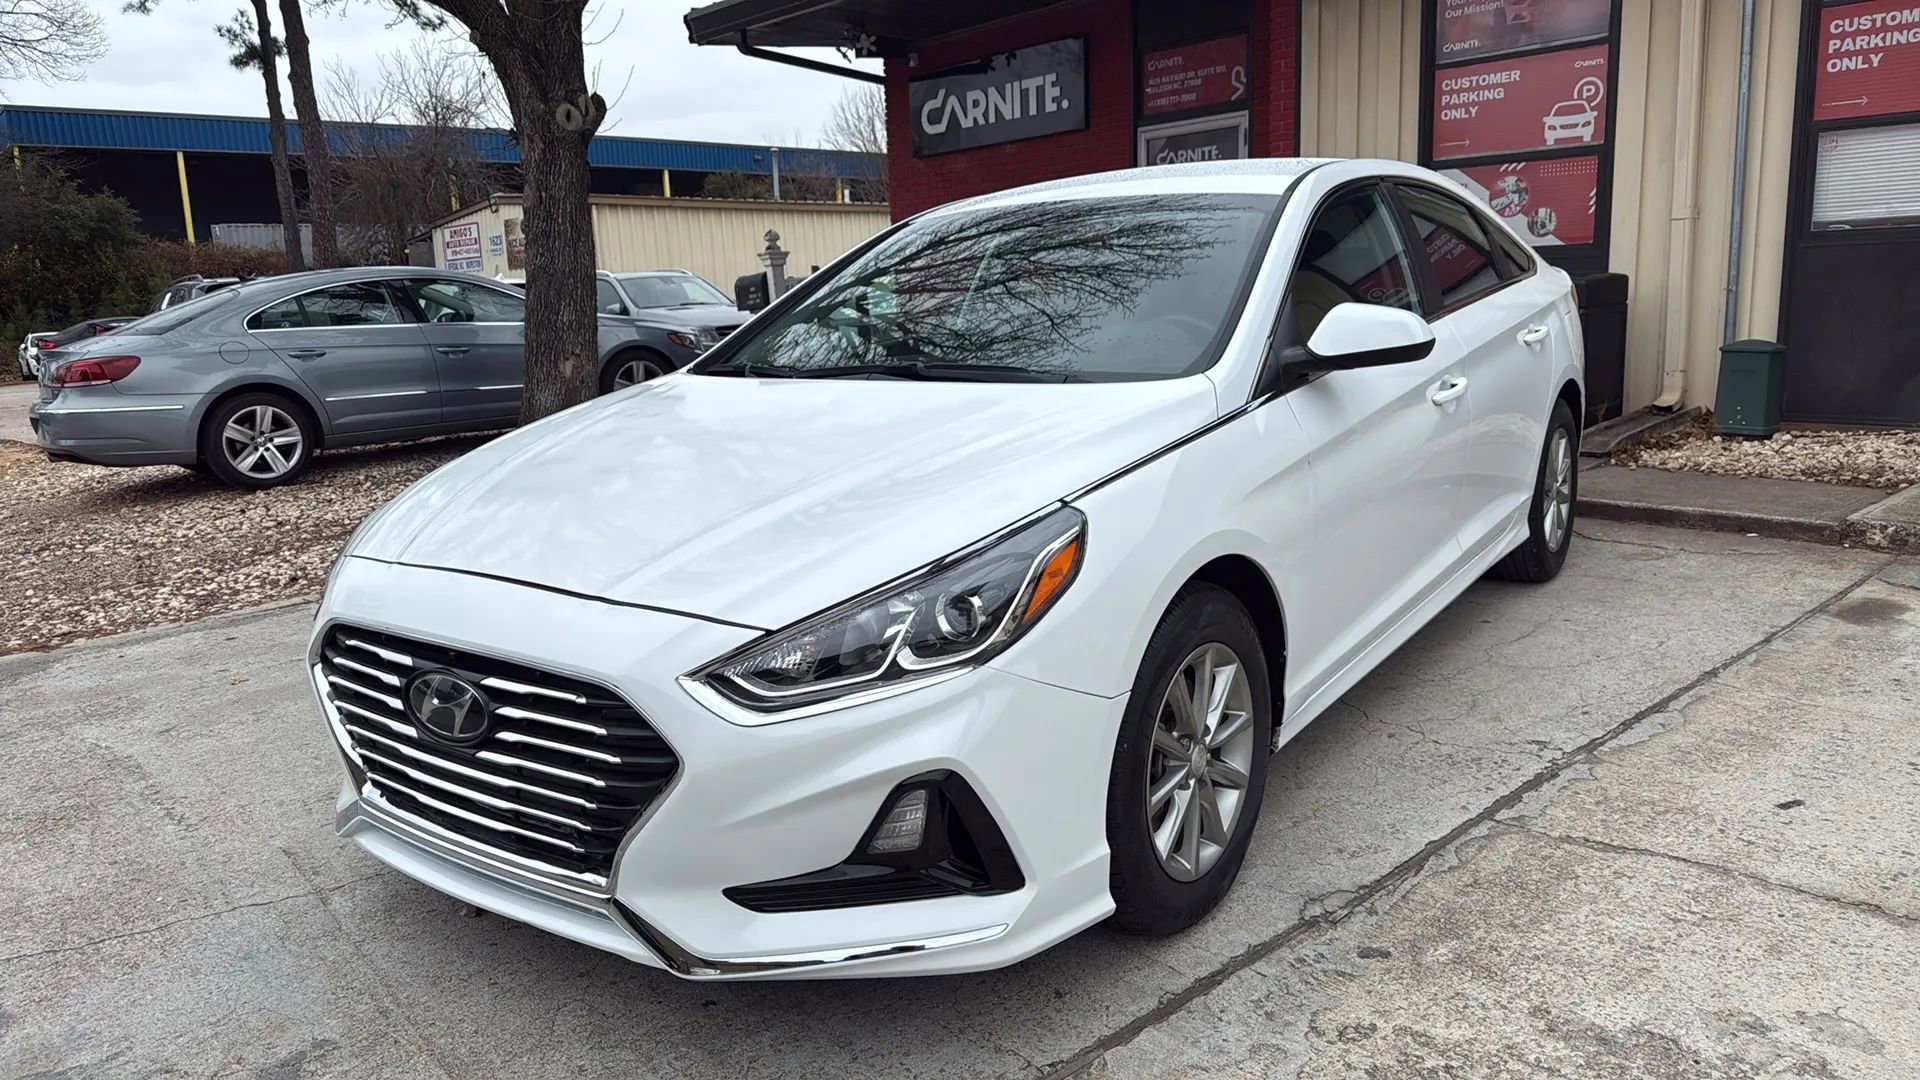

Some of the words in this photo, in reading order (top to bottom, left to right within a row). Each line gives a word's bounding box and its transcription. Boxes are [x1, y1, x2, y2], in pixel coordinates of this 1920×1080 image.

[1445, 9, 1463, 18] Our
[1828, 28, 1920, 54] PARKING
[1826, 53, 1884, 73] ONLY
[1442, 70, 1521, 91] CUSTOMER
[920, 72, 1070, 135] CARNITE.
[1441, 88, 1505, 106] PARKING
[1441, 106, 1480, 121] ONLY
